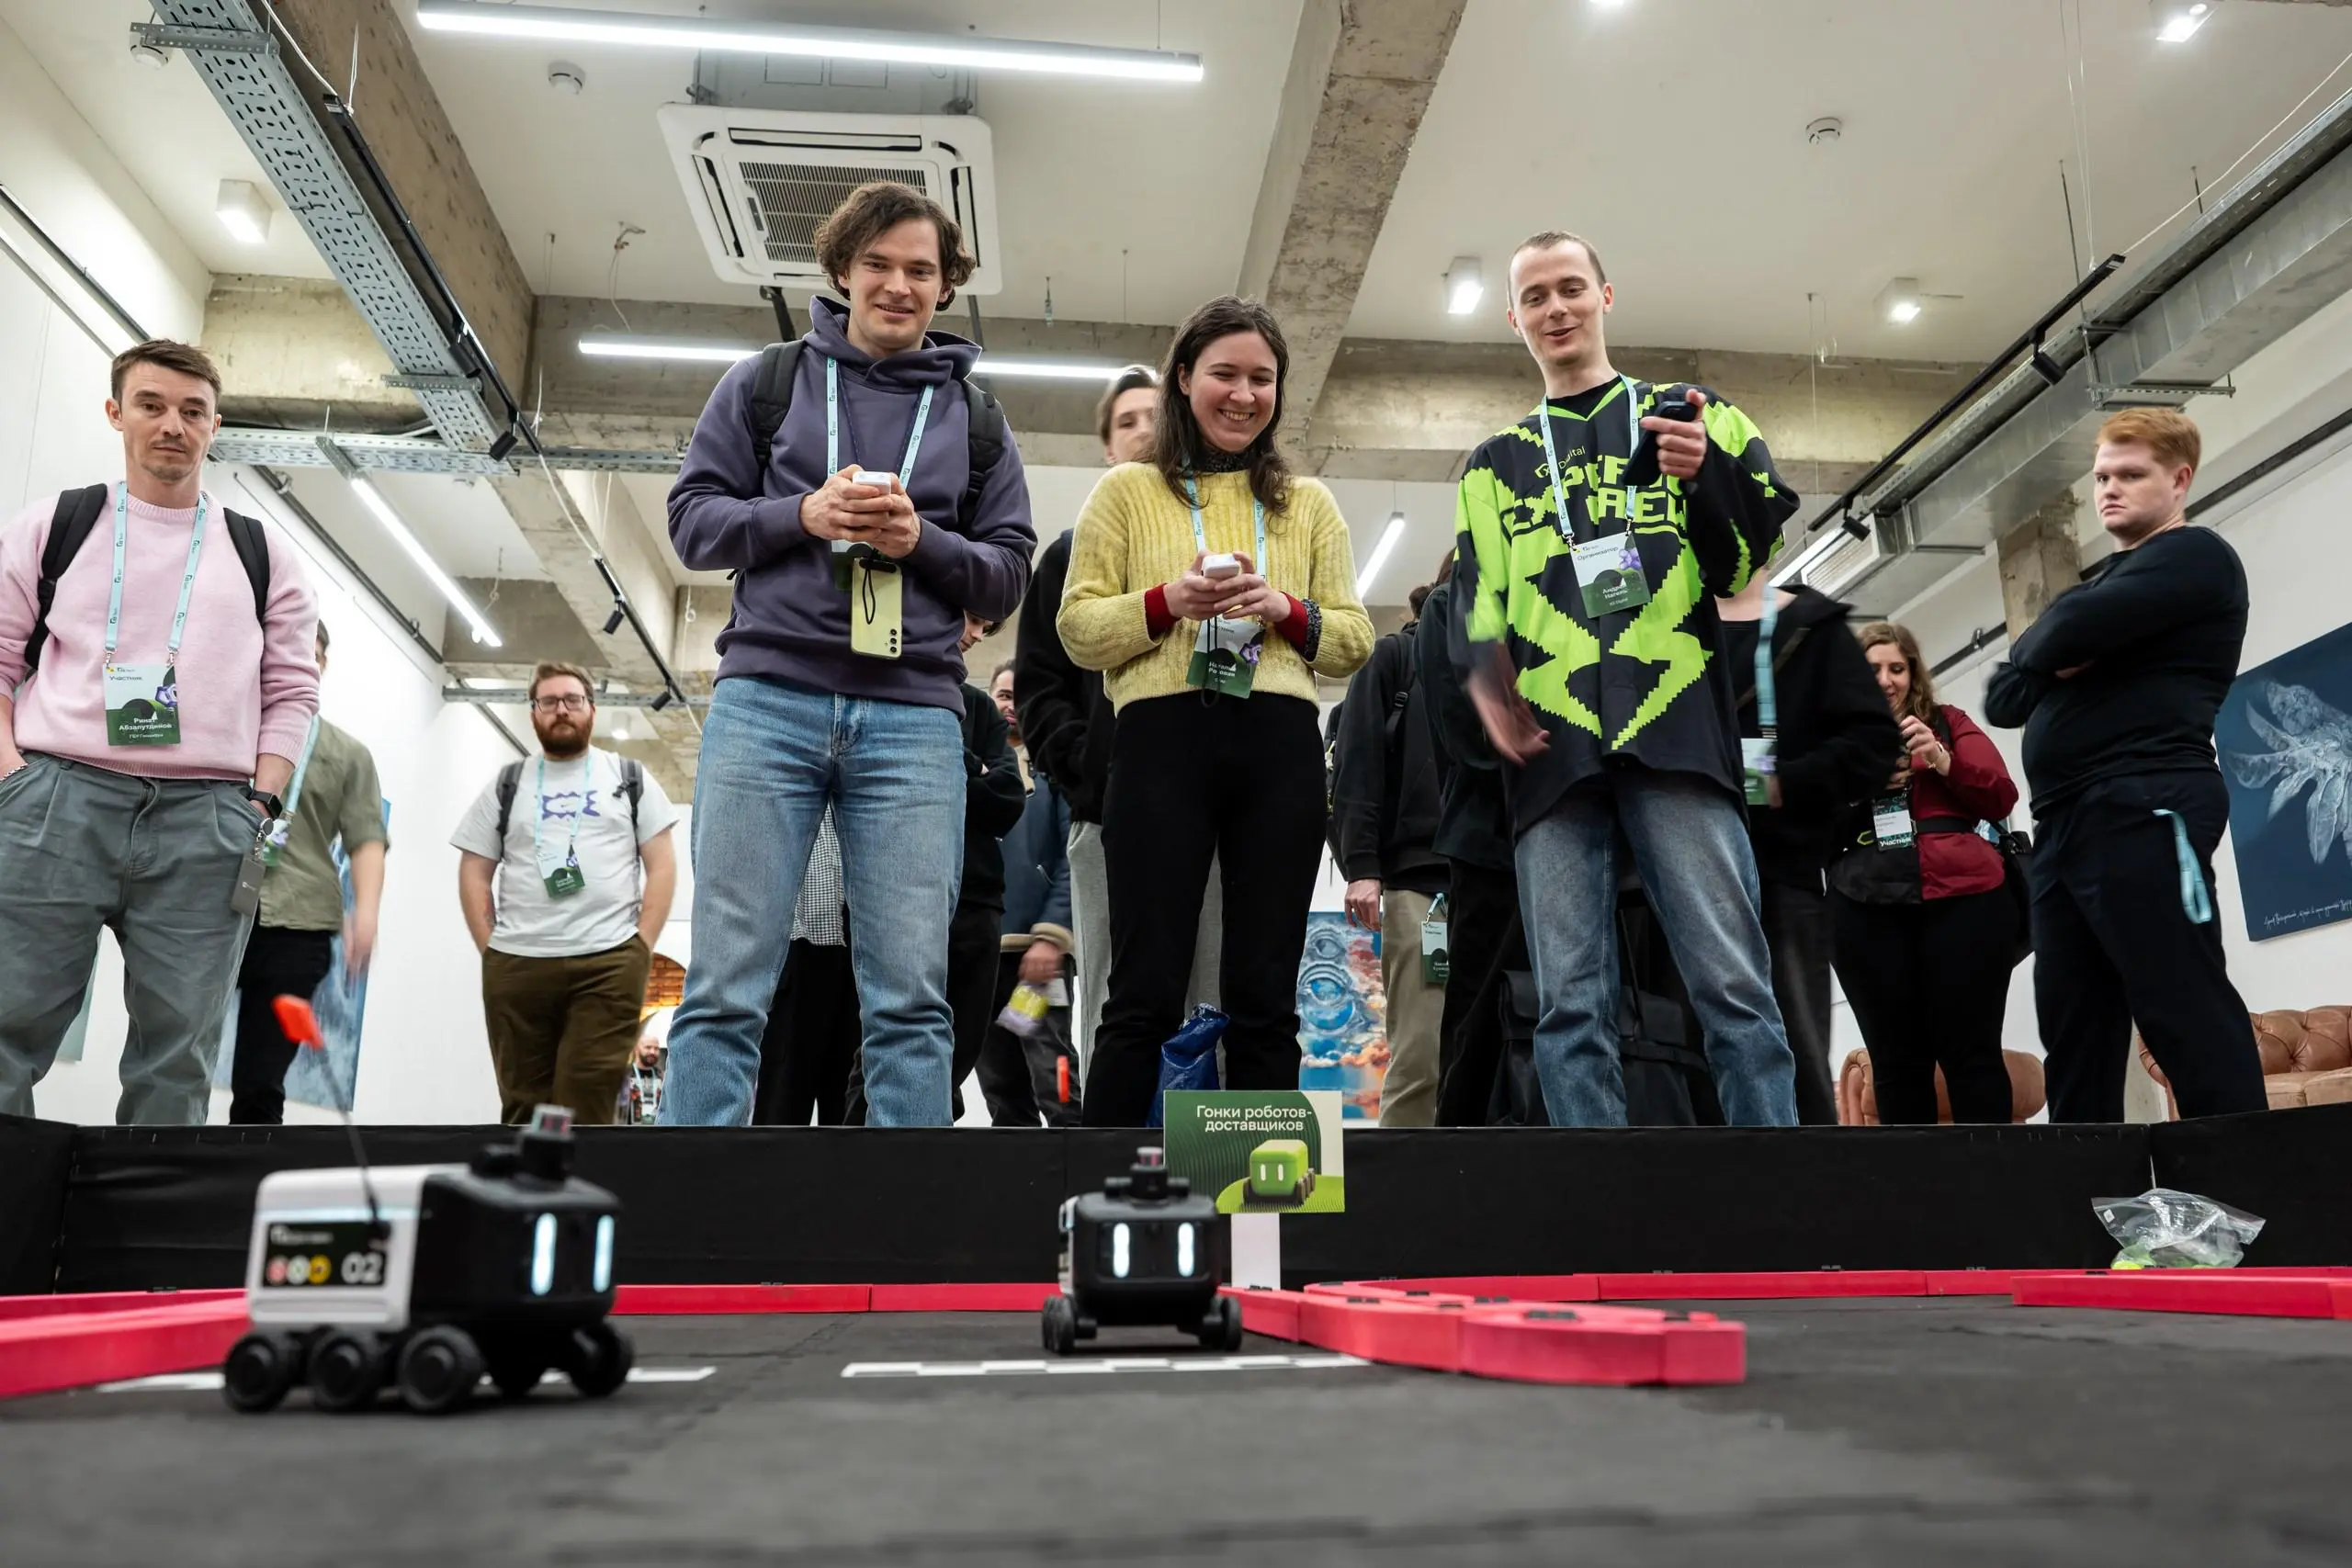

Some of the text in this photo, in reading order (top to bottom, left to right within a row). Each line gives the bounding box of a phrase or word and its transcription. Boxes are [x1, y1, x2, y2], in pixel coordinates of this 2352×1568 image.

[1196, 1105, 1313, 1121] Гонки роботов-
[1204, 1120, 1305, 1133] доставщиков
[341, 1251, 383, 1284] 02
